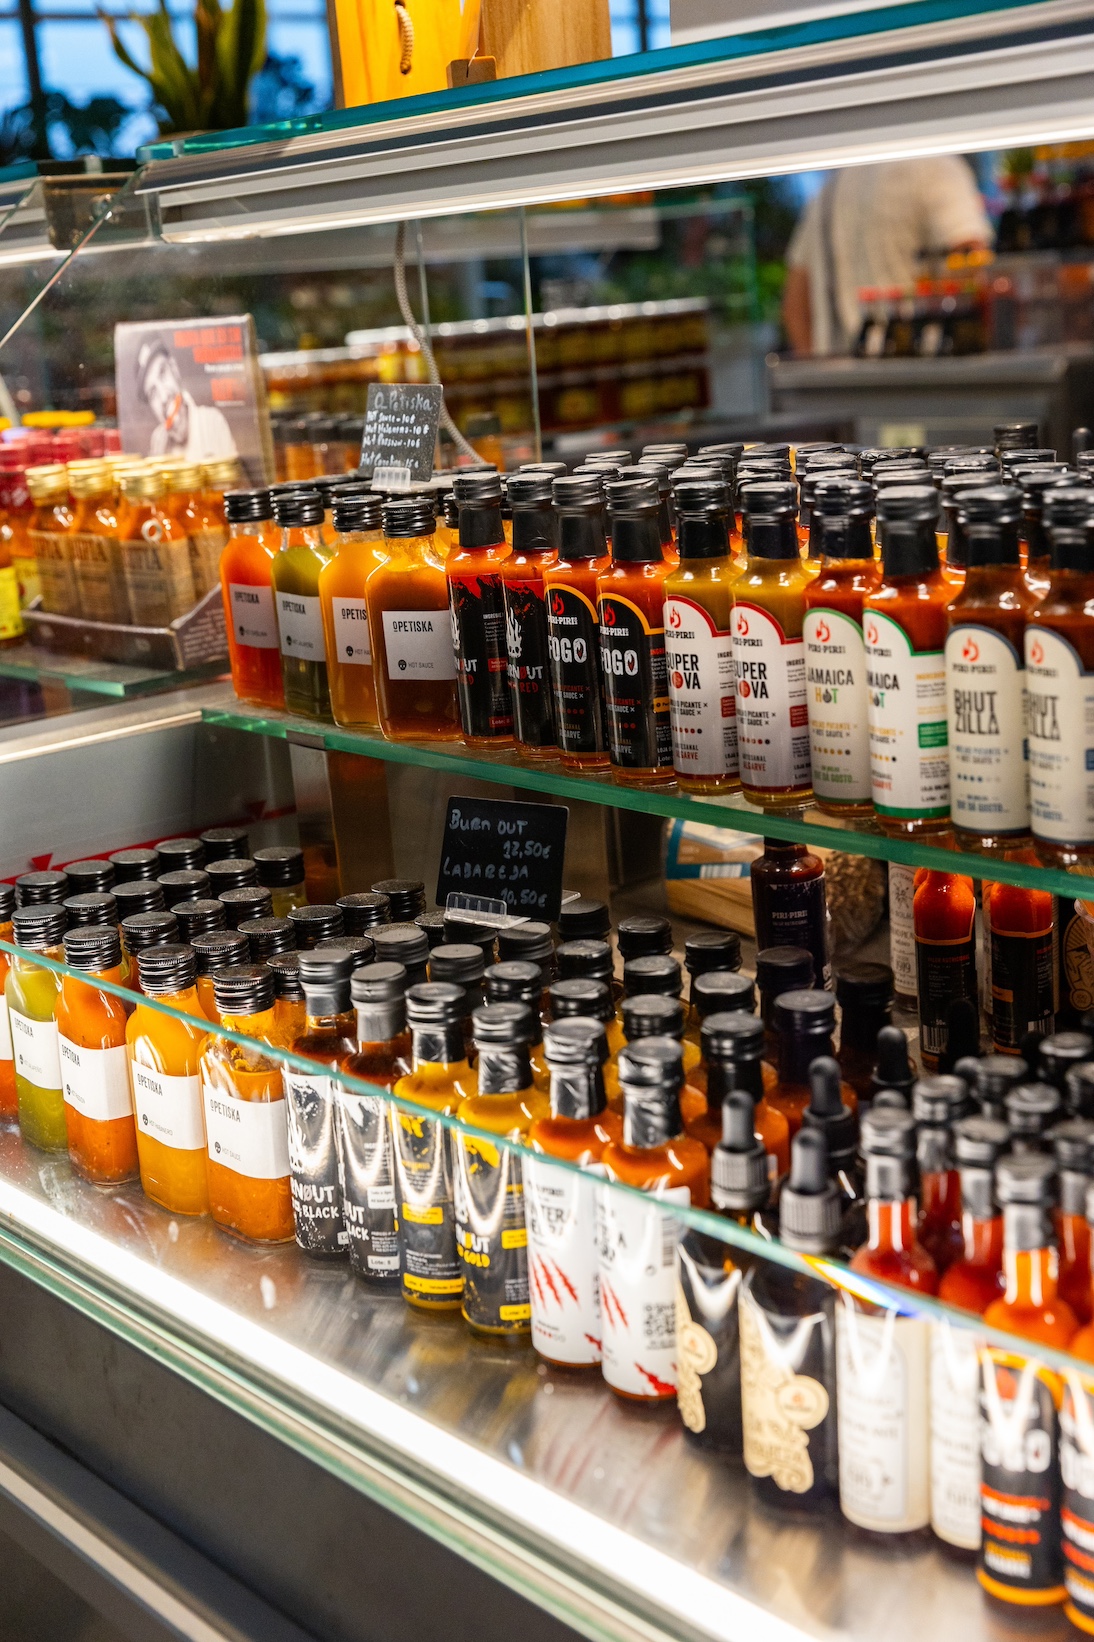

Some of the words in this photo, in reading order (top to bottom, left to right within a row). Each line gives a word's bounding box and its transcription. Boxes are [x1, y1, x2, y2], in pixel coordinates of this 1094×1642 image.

[393, 620, 434, 632] OPETISKA
[666, 652, 699, 672] SUPER
[734, 660, 767, 680] SUPER
[668, 670, 701, 690] NOVA
[807, 668, 854, 686] JAMAICA
[735, 679, 769, 699] NOVA
[680, 701, 701, 709] PICANTE
[954, 689, 997, 712] BHUT
[680, 708, 695, 716] SAUCE
[747, 710, 769, 719] PICANTE
[955, 710, 1000, 735] ZILLA
[137, 1073, 163, 1096] OPETISKA
[210, 1099, 241, 1122] OPETISKA
